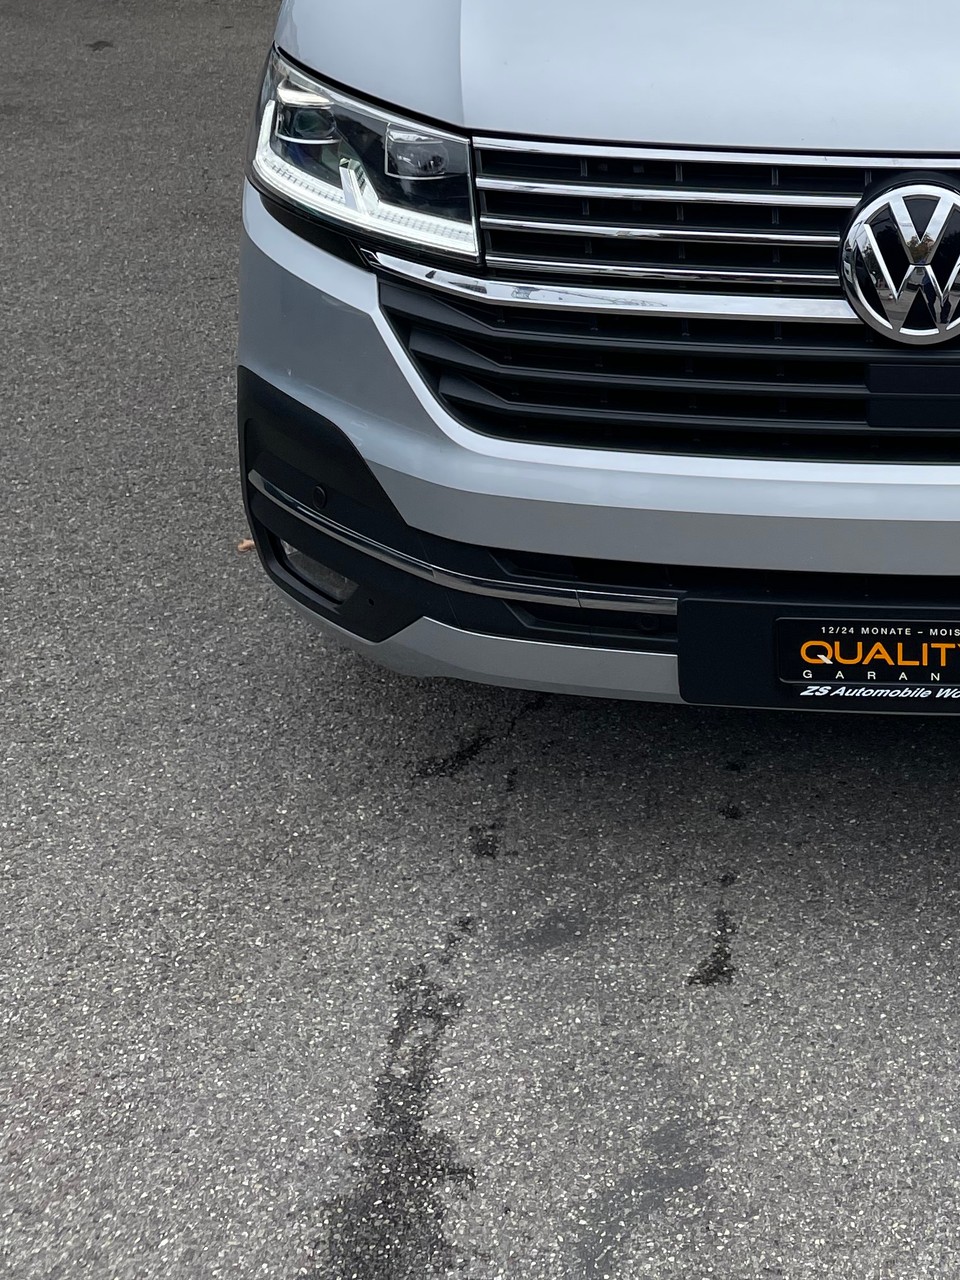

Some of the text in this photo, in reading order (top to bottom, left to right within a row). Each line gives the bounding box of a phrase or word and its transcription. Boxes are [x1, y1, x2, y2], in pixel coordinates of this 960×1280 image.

[821, 626, 855, 634] 12/24
[861, 627, 911, 635] MONATE
[929, 628, 960, 636] MOIS
[800, 685, 832, 696] ZS
[830, 686, 932, 698] Automobile
